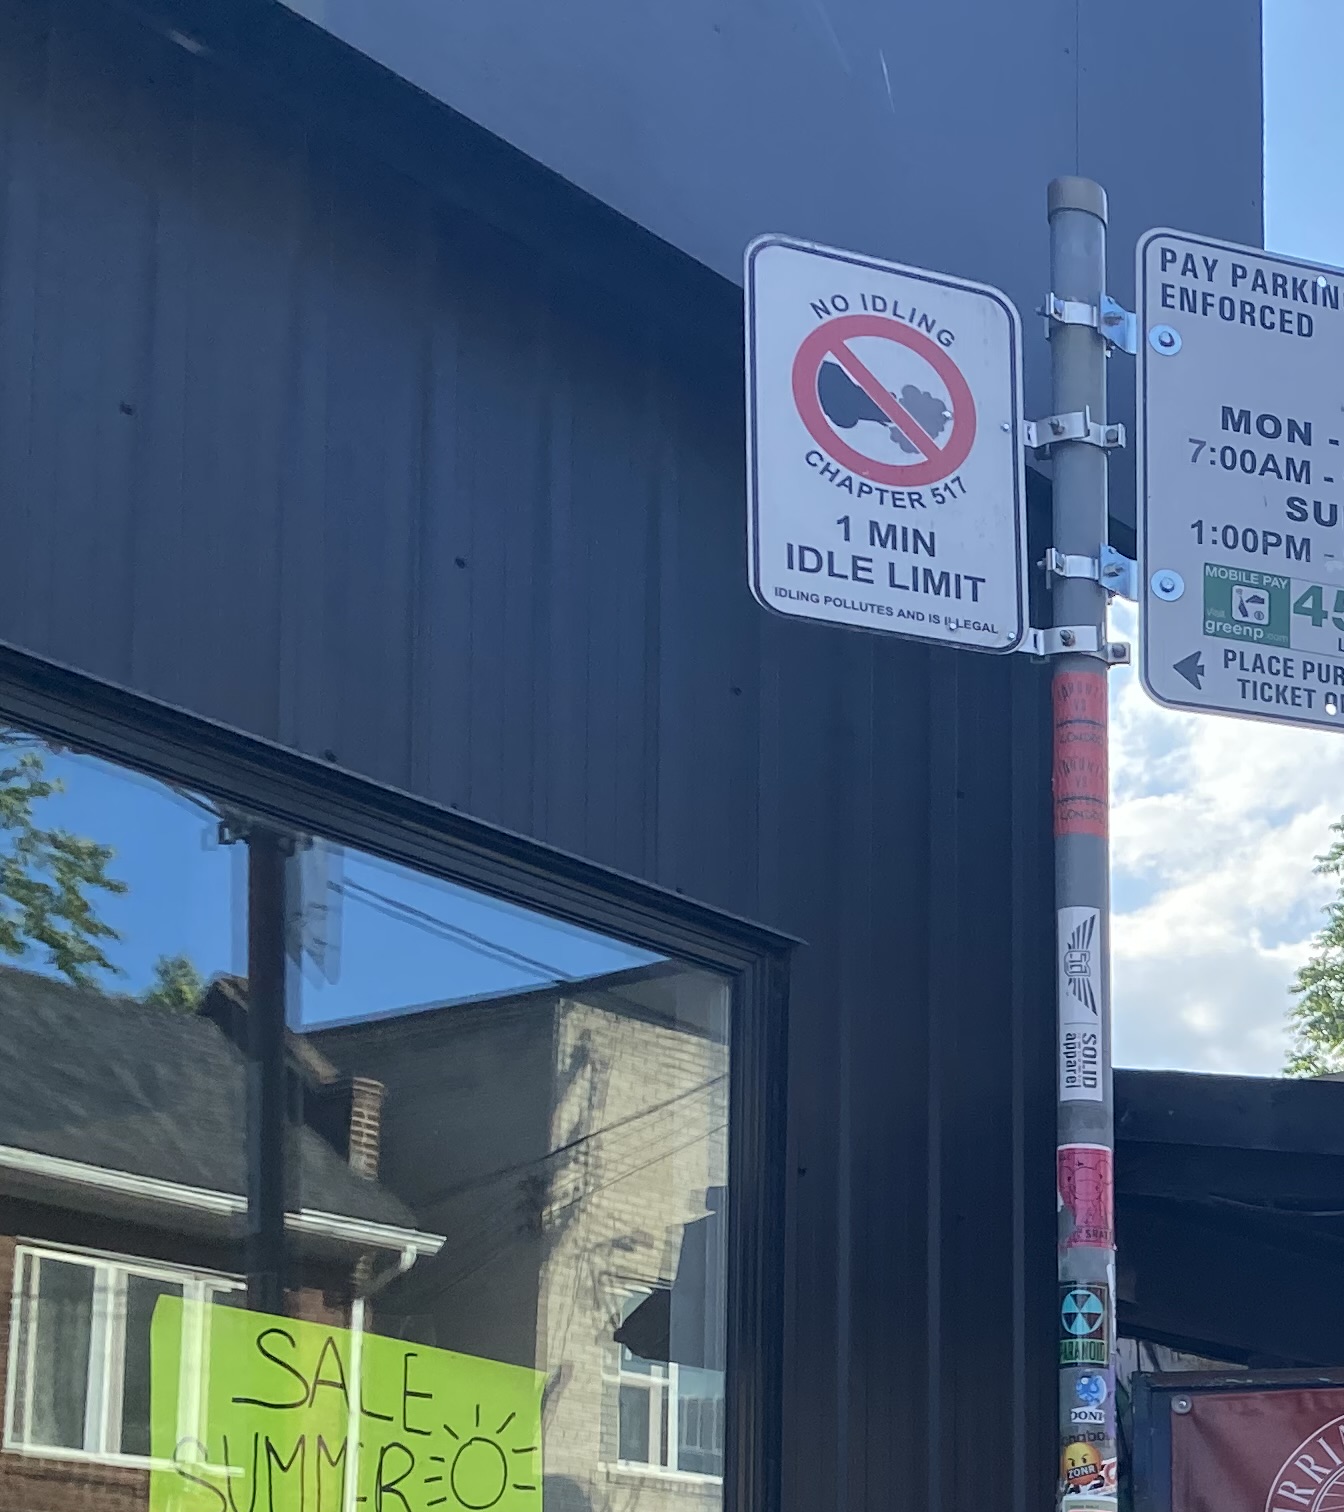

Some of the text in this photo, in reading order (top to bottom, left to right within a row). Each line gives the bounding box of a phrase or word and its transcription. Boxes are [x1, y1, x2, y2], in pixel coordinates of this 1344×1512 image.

[1160, 246, 1219, 284] PAY
[810, 293, 956, 348] NO IDLING
[1160, 283, 1314, 340] ENFORCED
[1220, 405, 1313, 447] MON
[805, 448, 968, 510] CHAPTER 517
[1187, 437, 1312, 486] 7:00AM
[835, 514, 937, 558] 1 MIN
[1190, 518, 1312, 564] 1:00PM
[786, 542, 987, 603] IDLE LIMIT
[1205, 565, 1288, 590] MOBILE PAY
[774, 586, 1000, 635] IDLING POLLUTES AND IS ILLEGAL
[1223, 648, 1295, 681] PLACE
[1236, 678, 1315, 710] TICKET
[231, 1327, 434, 1436] SALE
